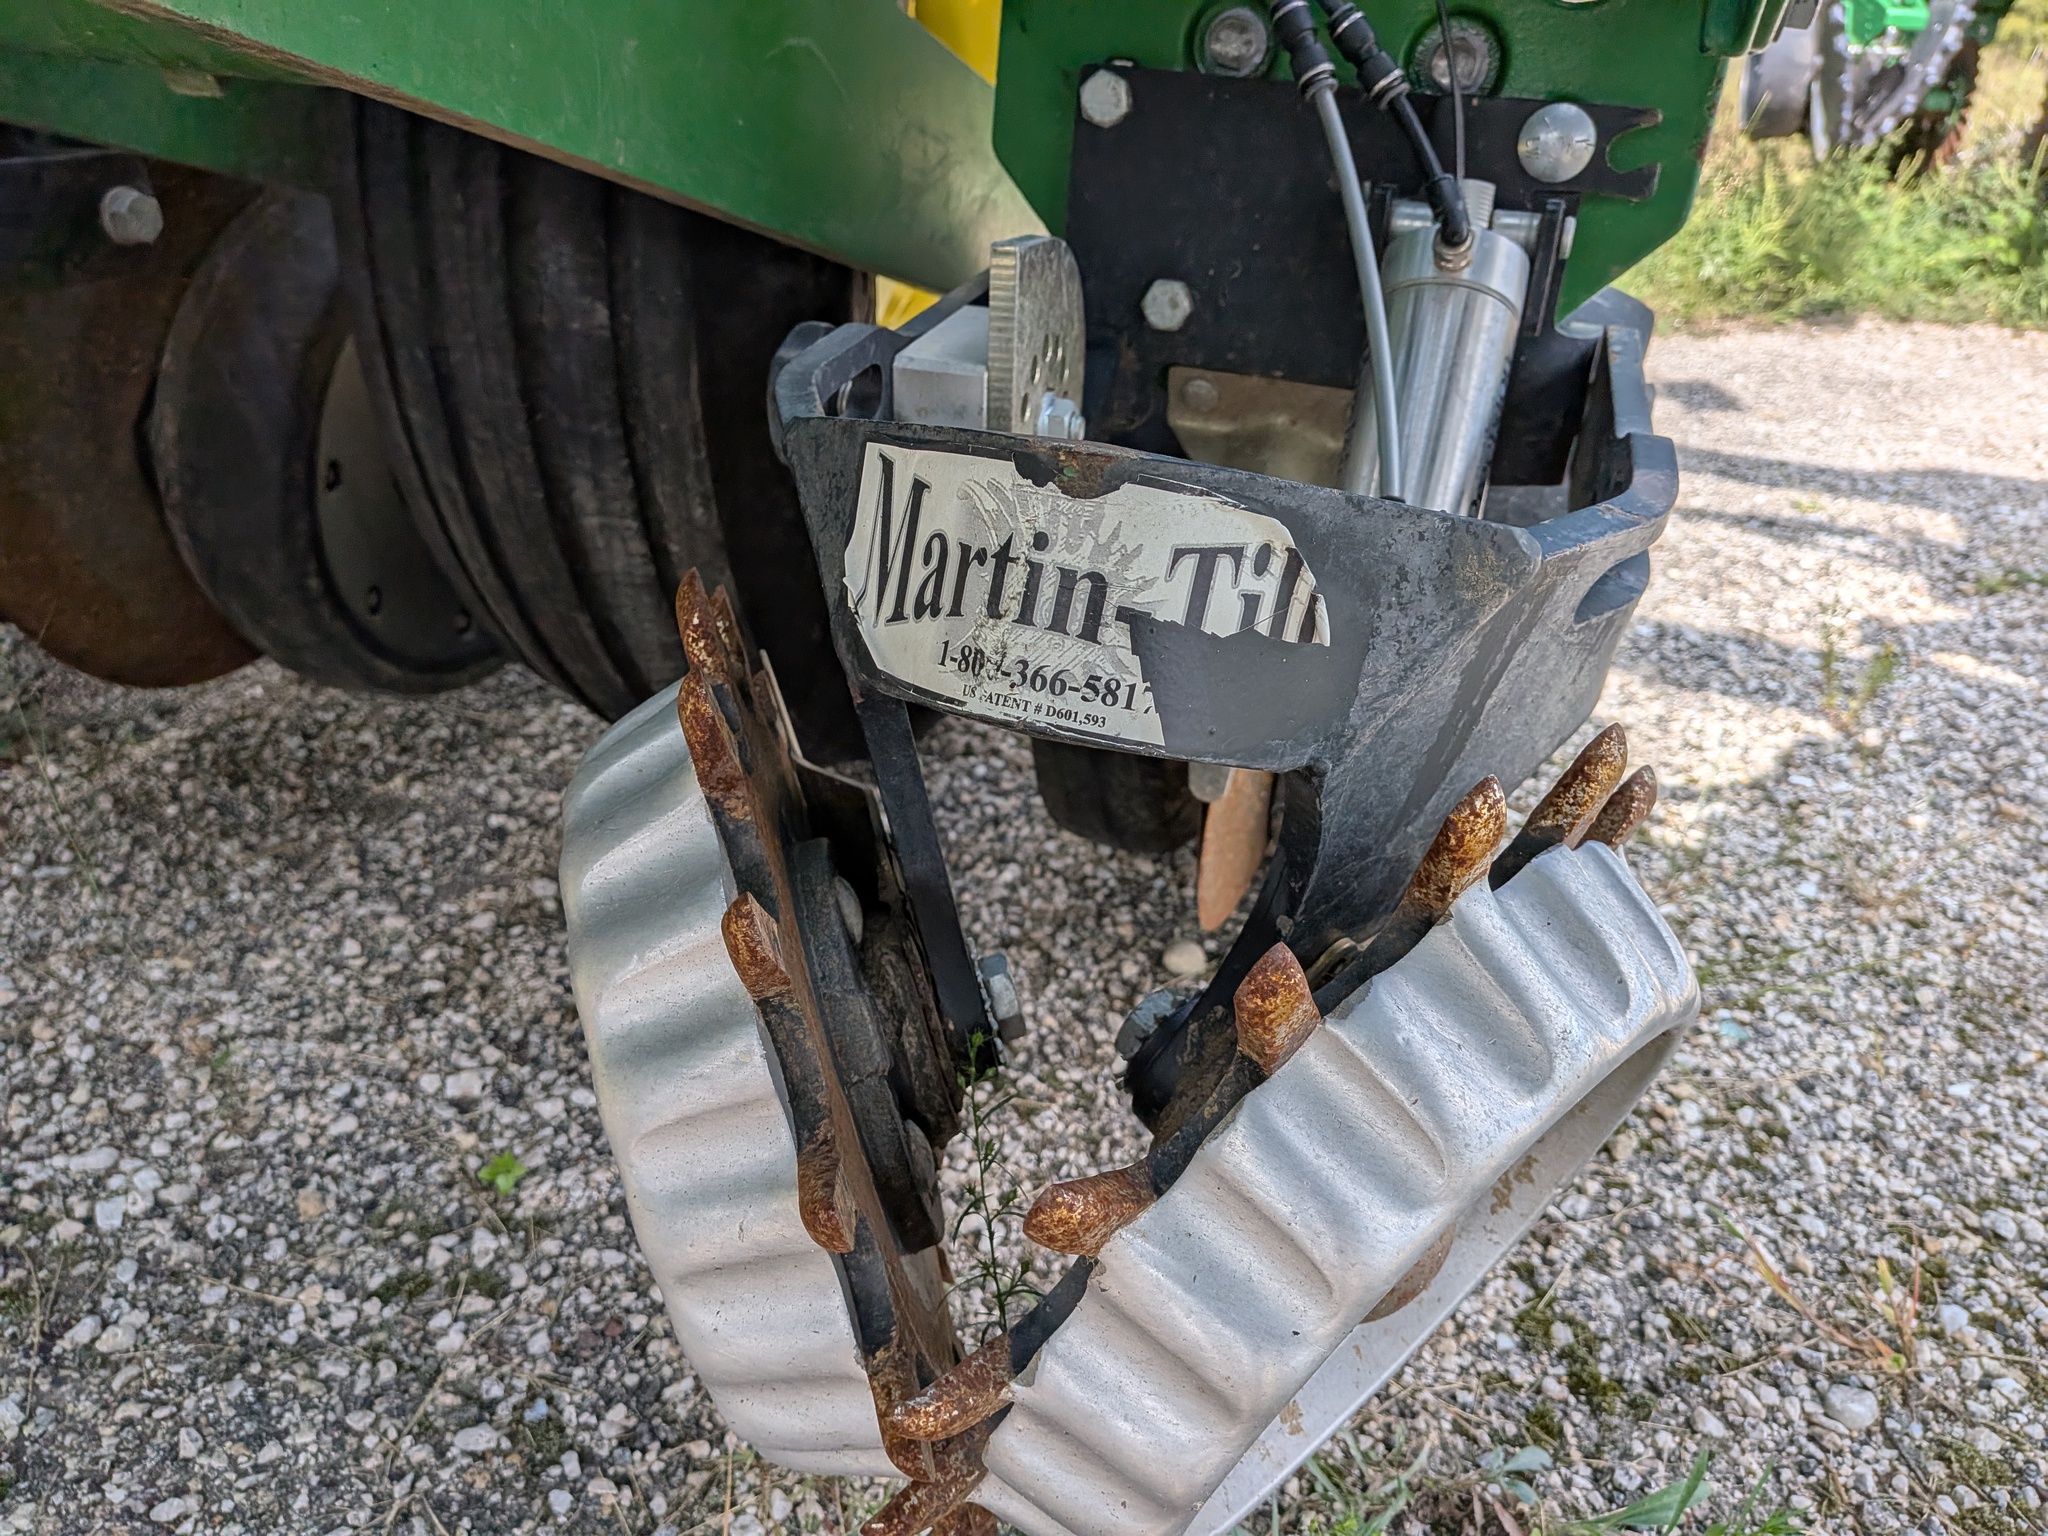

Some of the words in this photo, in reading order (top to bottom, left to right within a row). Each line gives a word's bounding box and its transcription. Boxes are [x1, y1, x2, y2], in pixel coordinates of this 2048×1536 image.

[963, 684, 977, 698] US
[1033, 702, 1043, 715] #
[1046, 705, 1107, 728] D601,593
